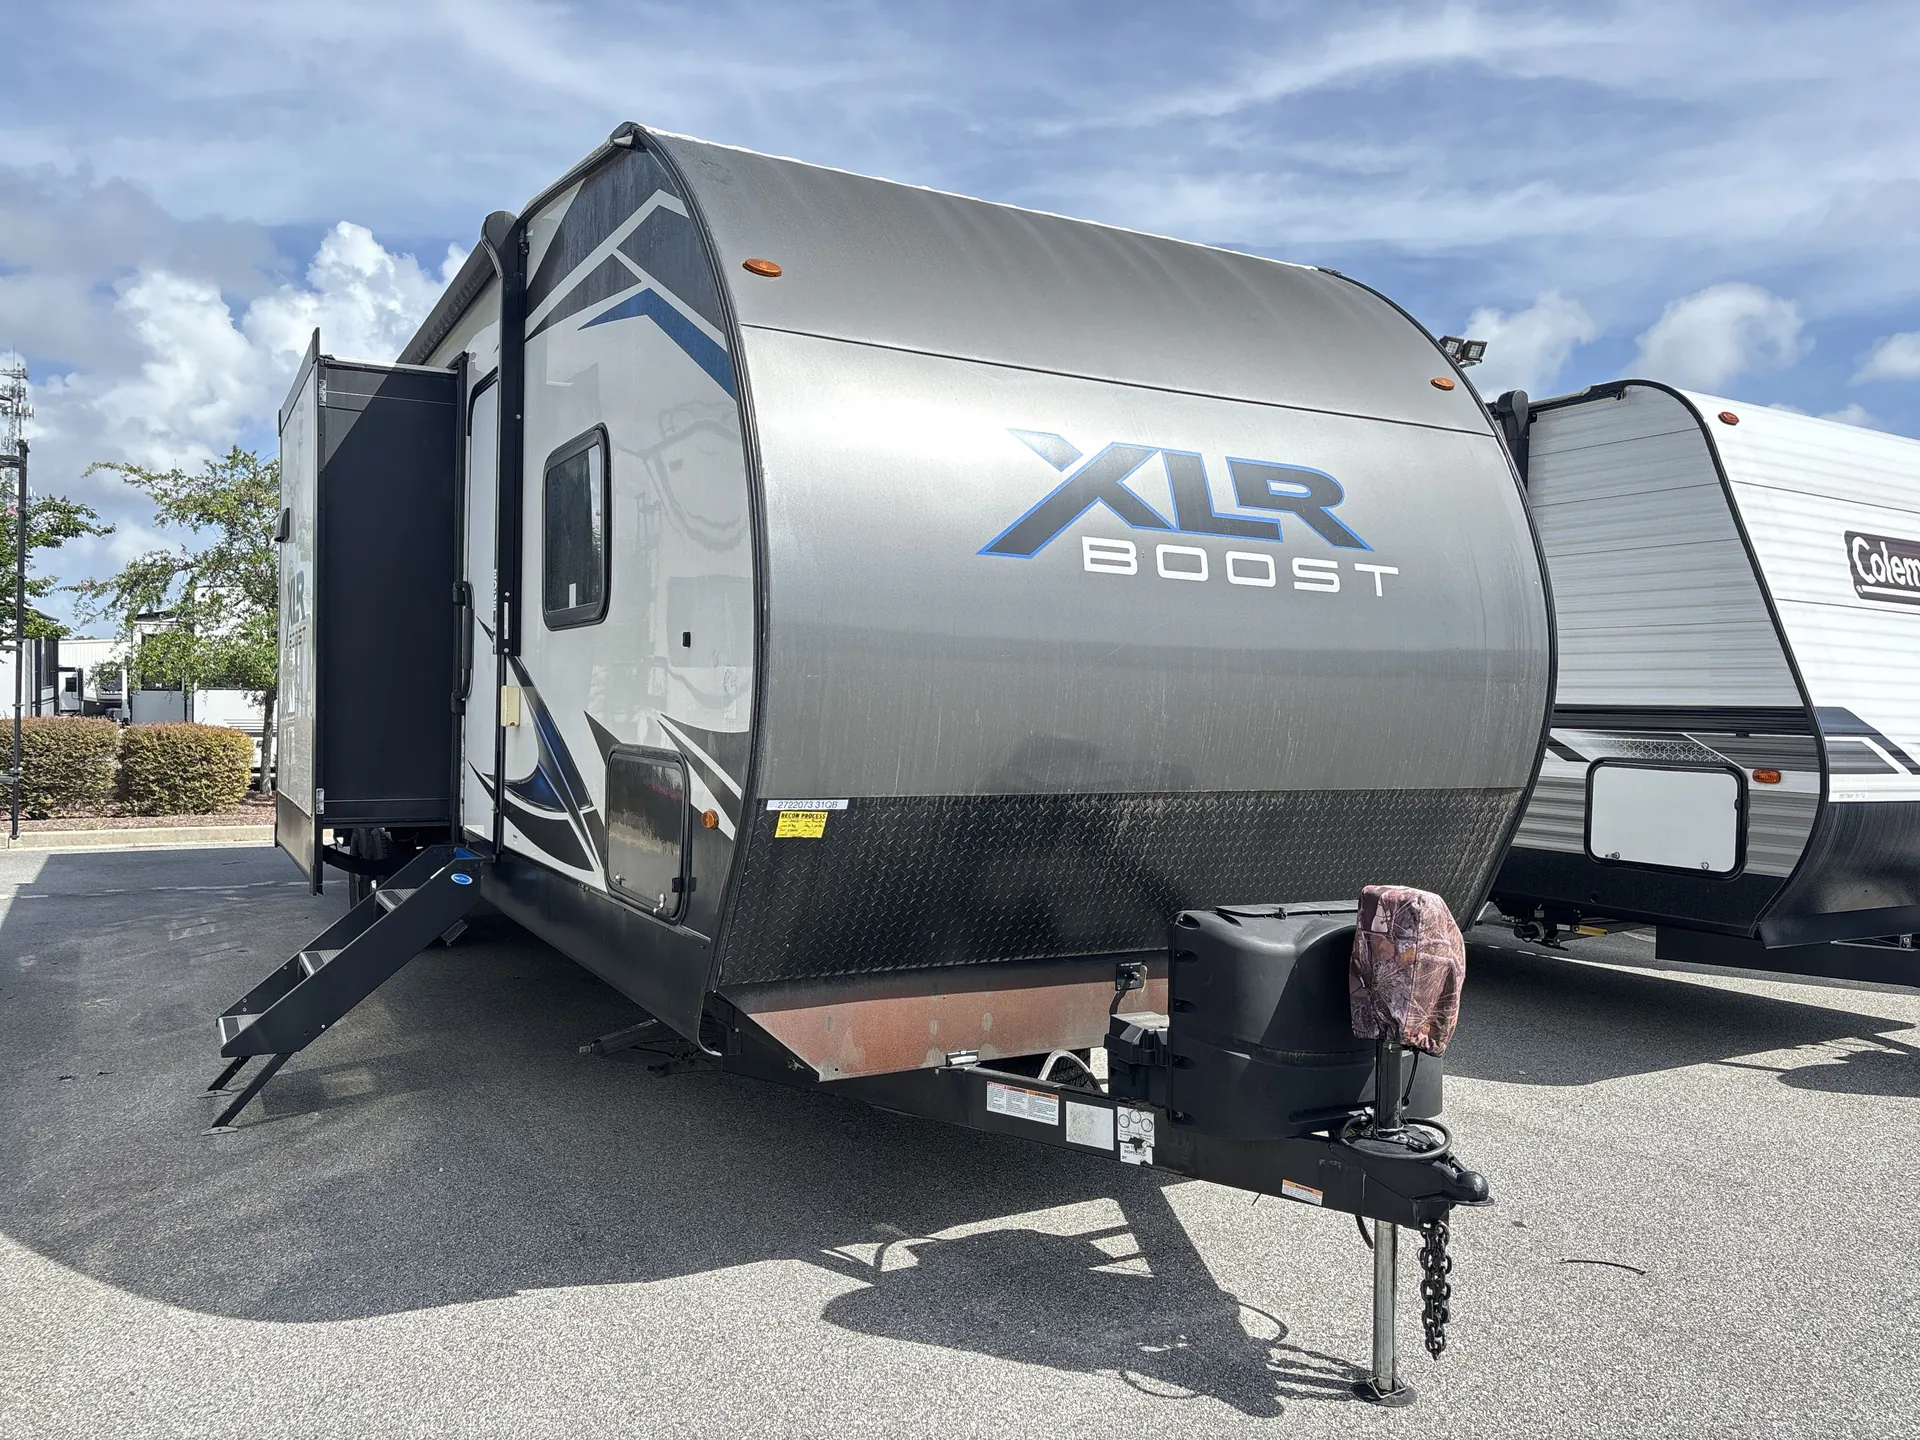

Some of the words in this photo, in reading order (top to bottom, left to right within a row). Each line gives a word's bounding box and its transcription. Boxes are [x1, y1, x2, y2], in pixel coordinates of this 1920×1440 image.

[976, 427, 1376, 560] XLR
[1081, 536, 1400, 598] BOOST
[778, 800, 813, 809] 2722073
[815, 800, 838, 809] 31QB
